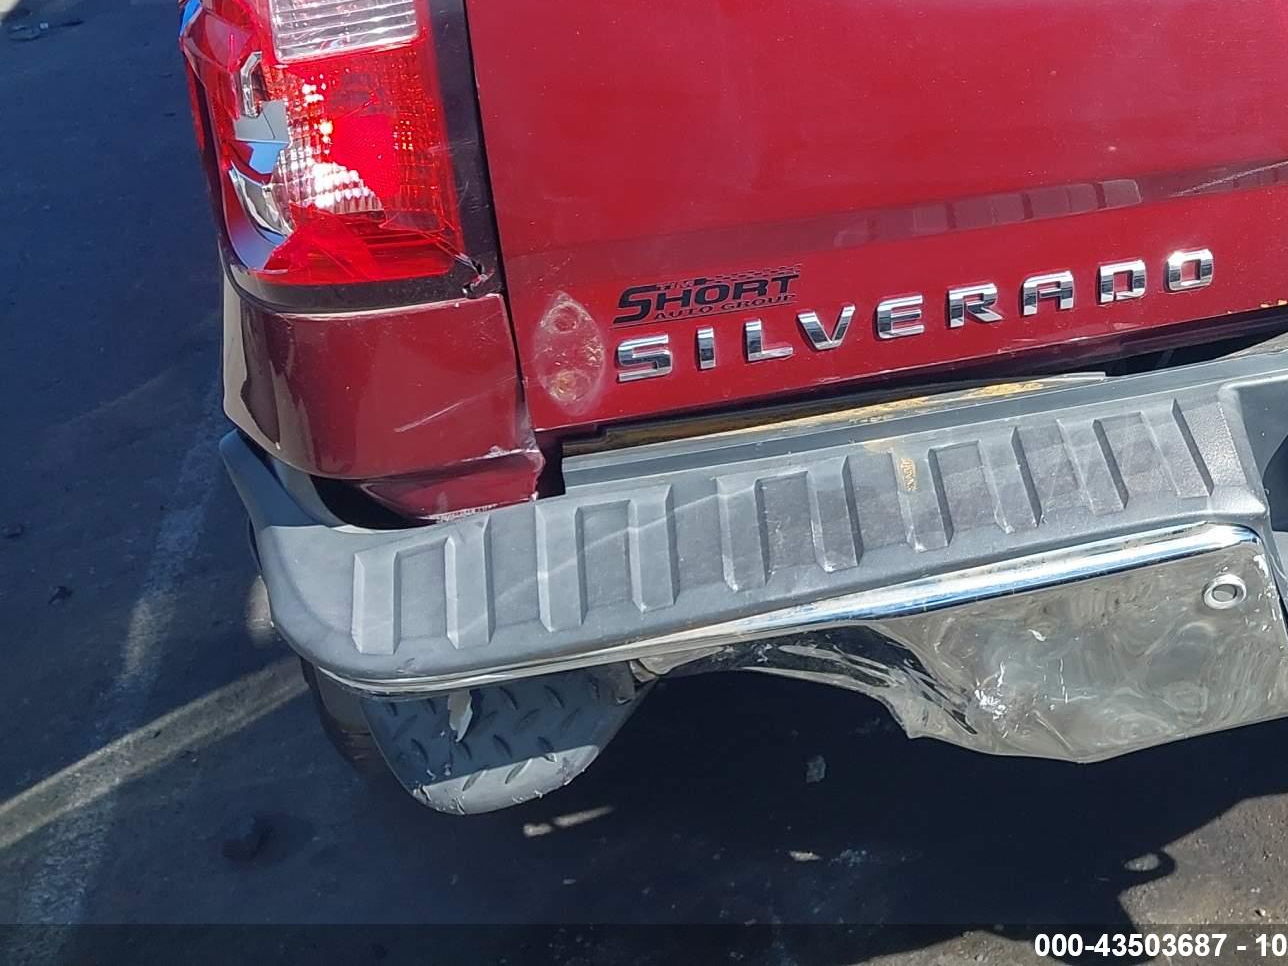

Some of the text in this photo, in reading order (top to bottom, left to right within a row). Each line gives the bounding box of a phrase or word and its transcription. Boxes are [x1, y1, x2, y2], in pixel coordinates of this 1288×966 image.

[613, 274, 800, 324] SHORT
[617, 248, 1214, 382] SILVERADO
[654, 294, 797, 321] AUTO GROUP
